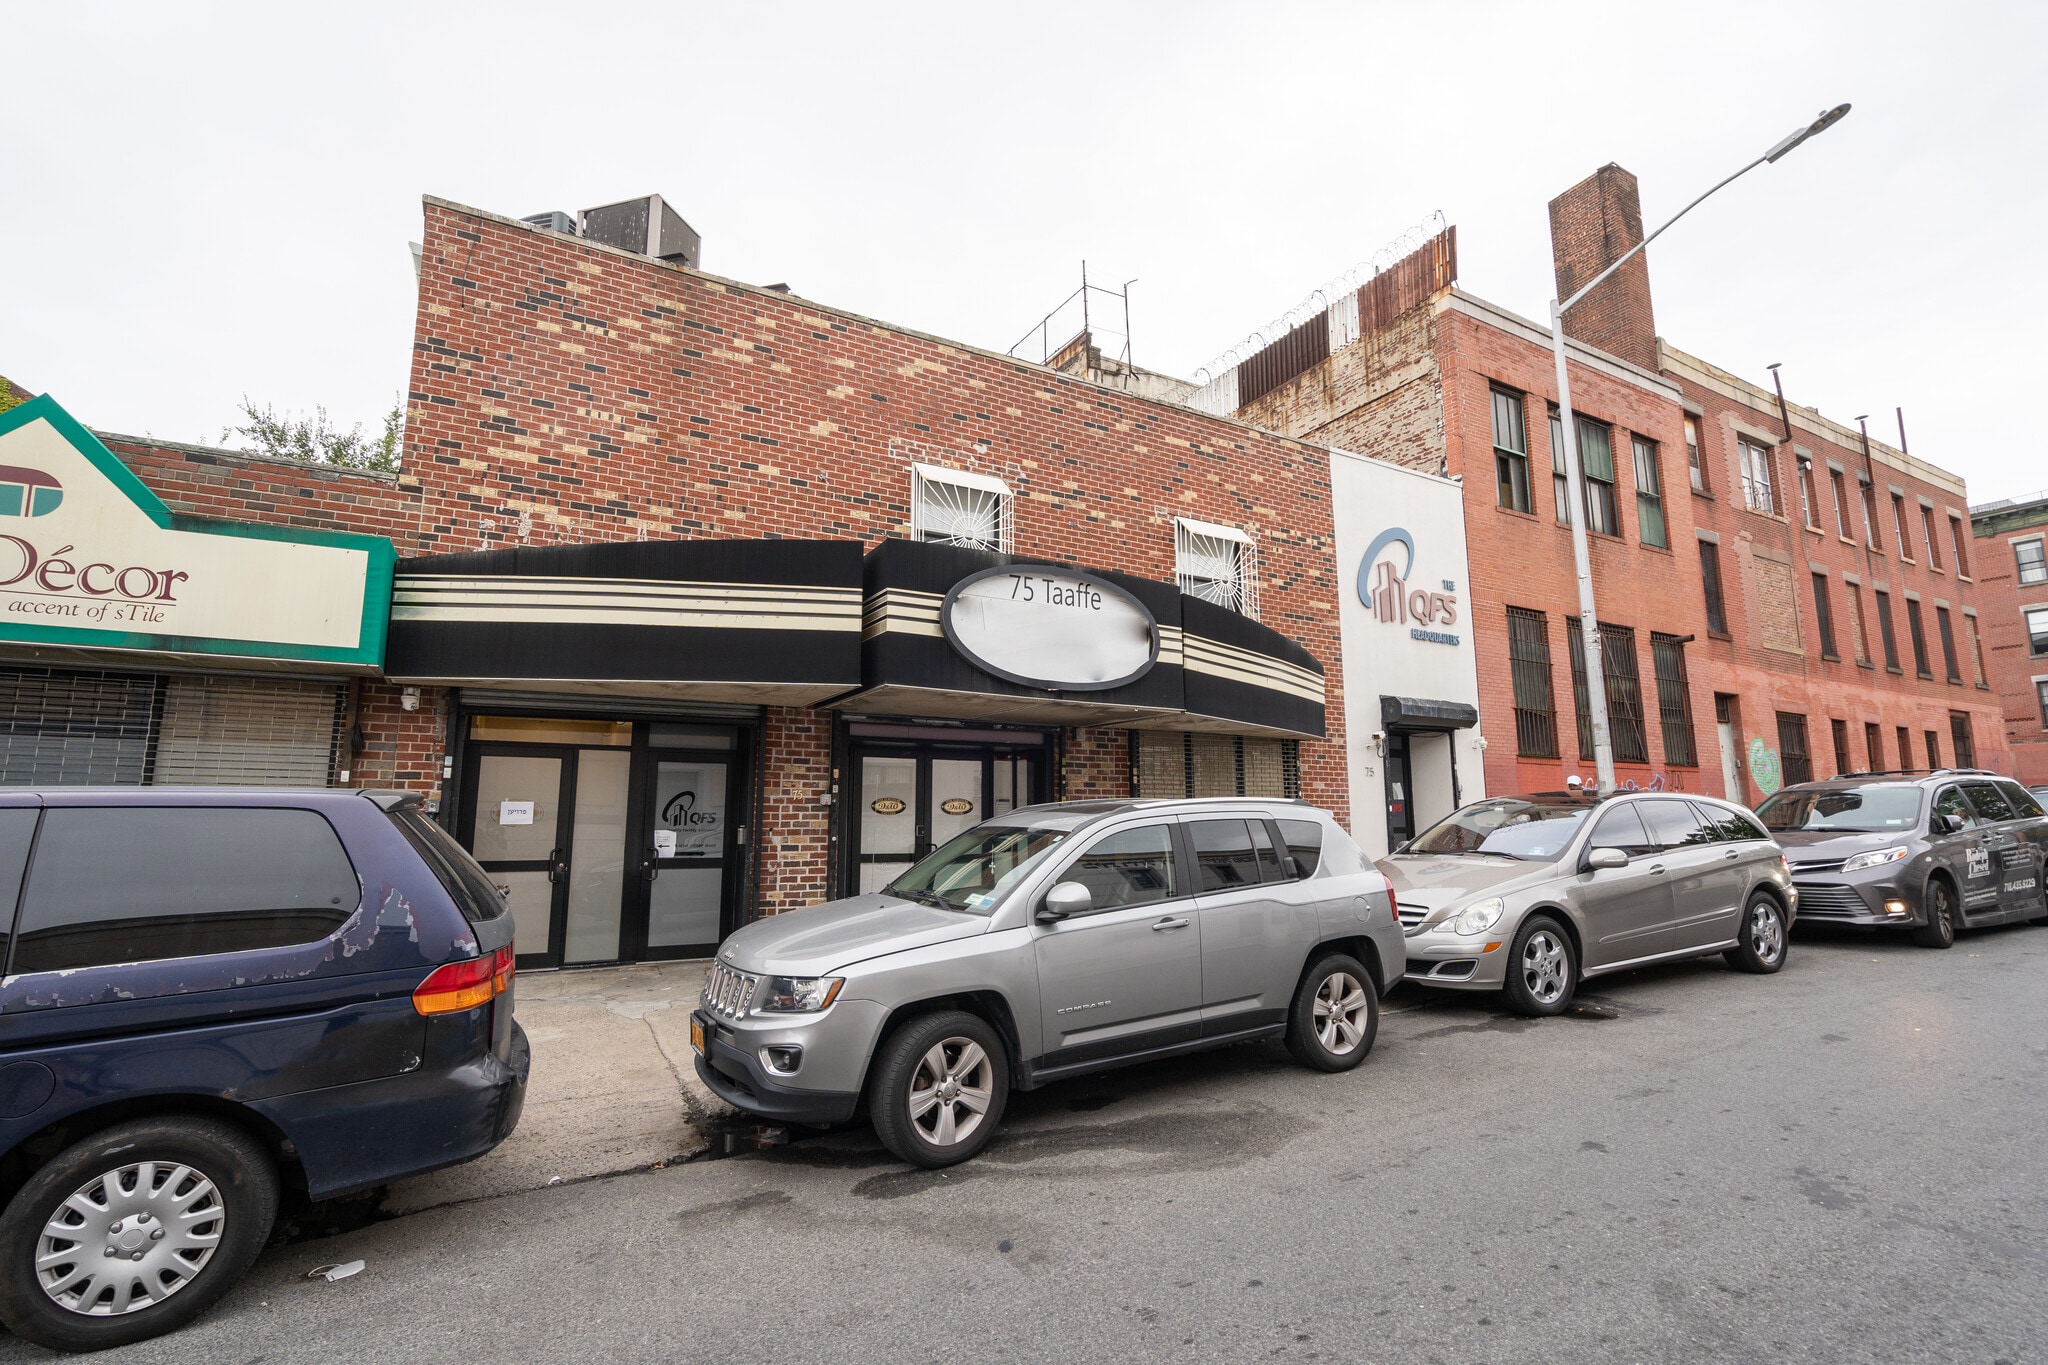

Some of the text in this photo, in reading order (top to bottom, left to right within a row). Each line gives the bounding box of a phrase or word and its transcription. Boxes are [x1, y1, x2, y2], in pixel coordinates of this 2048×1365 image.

[1009, 574, 1101, 610] 75 Taaffe
[1443, 579, 1455, 591] THE
[8, 601, 164, 623] accent of sTile
[1409, 589, 1457, 625] QFS
[1411, 628, 1460, 645] HEADQUARTERS
[1365, 767, 1374, 777] 75
[792, 790, 803, 800] 75
[690, 812, 716, 825] QFS
[1057, 1000, 1111, 1015] COMPASS
